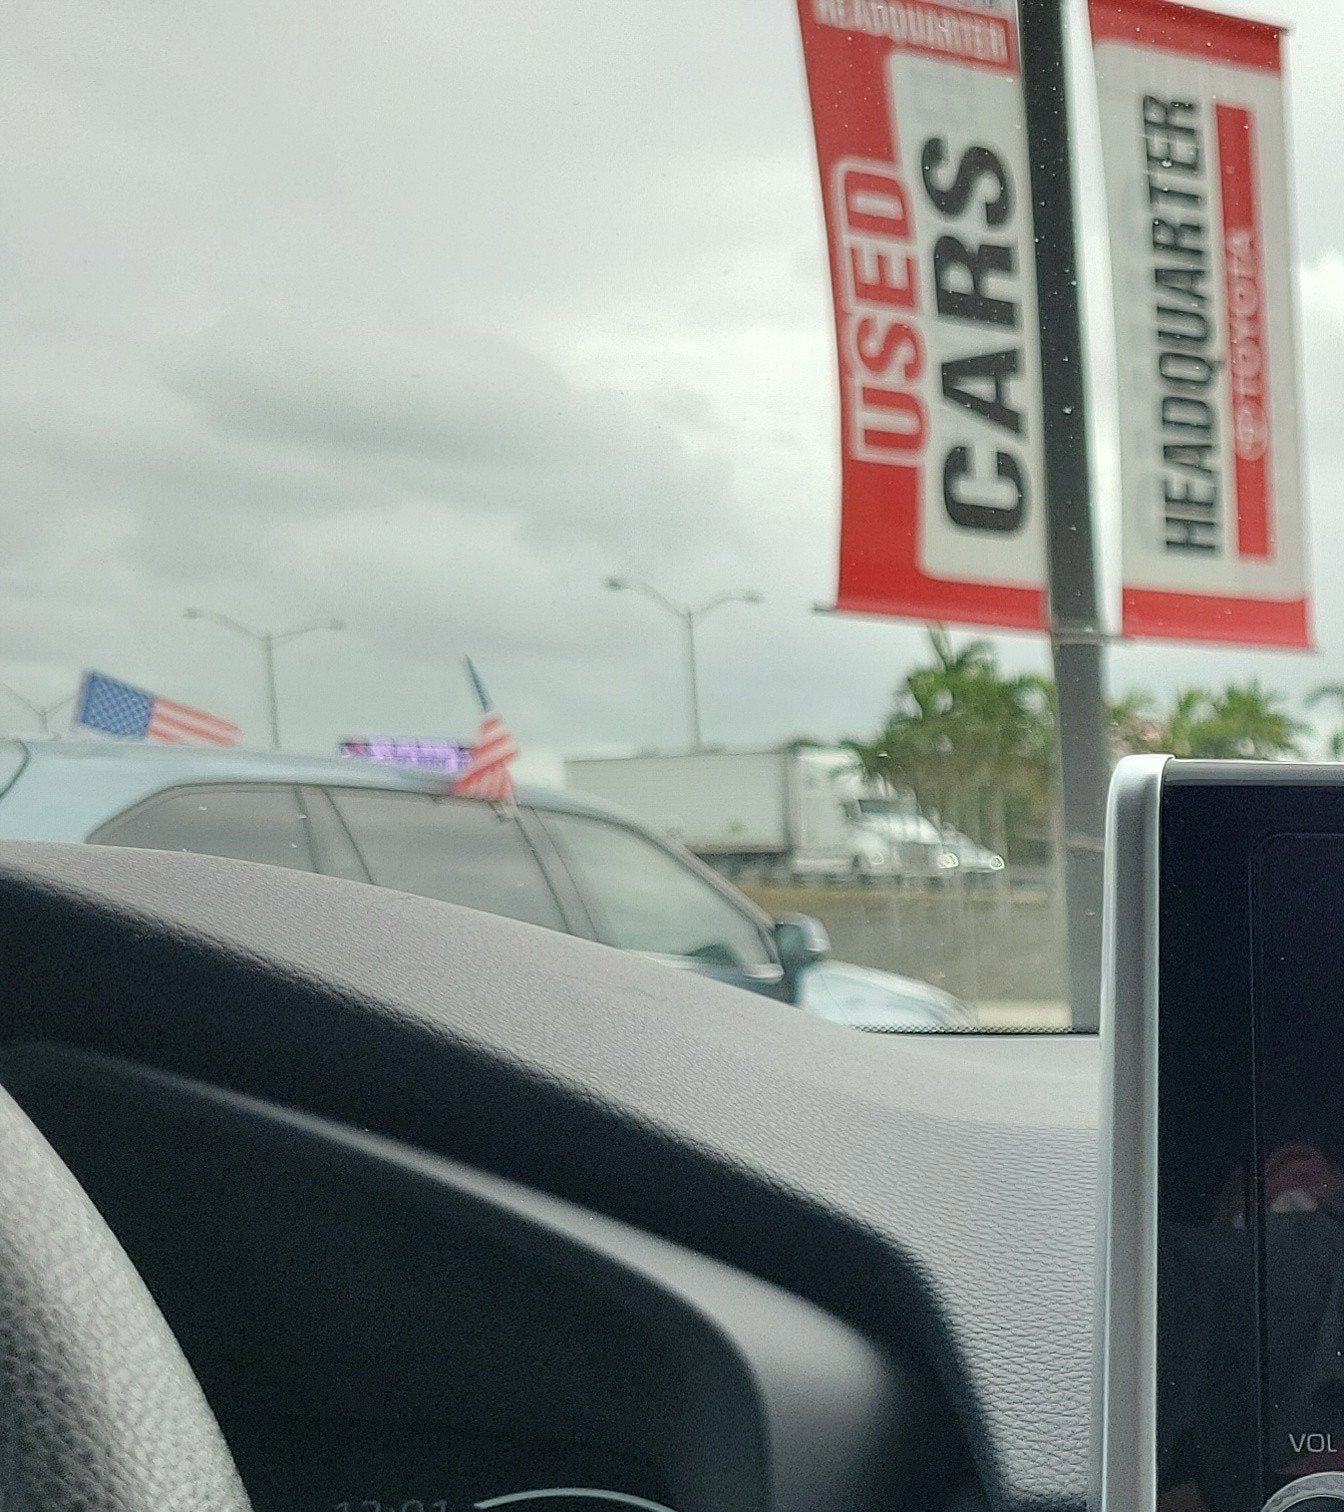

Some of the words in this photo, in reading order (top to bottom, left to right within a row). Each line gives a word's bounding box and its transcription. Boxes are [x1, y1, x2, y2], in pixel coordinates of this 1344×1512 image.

[842, 167, 927, 455] USED
[922, 137, 1030, 537] CARS
[1143, 95, 1223, 557] HEADQUARTER
[1288, 1433, 1338, 1453] VOL
